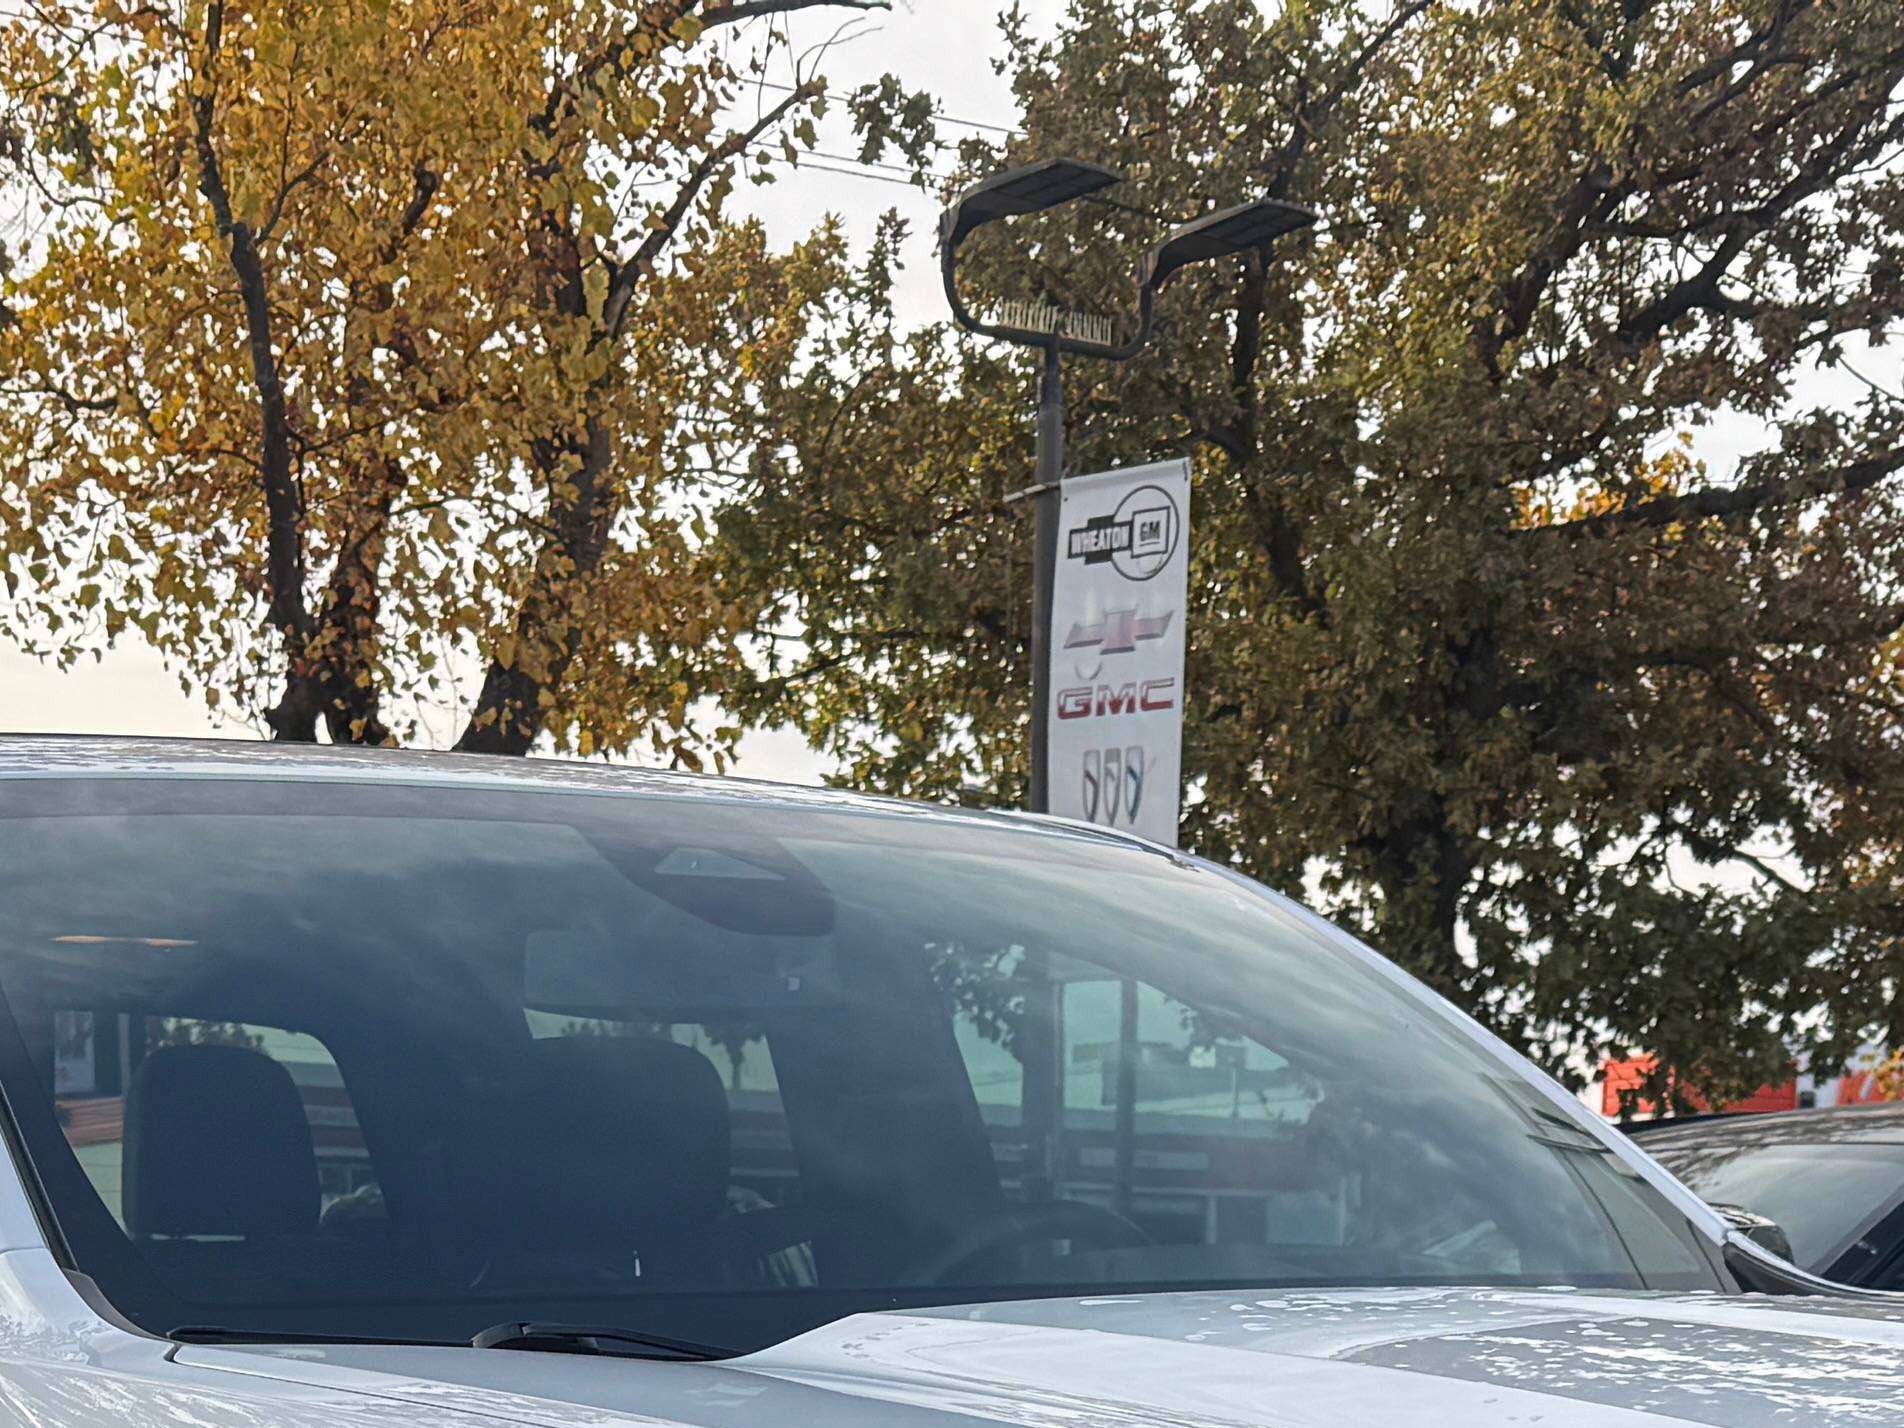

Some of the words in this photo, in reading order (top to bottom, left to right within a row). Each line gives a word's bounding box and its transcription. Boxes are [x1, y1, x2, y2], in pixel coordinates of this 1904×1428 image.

[1070, 526, 1130, 553] WHEATON
[1140, 520, 1161, 541] GM
[1057, 677, 1175, 720] GMC
